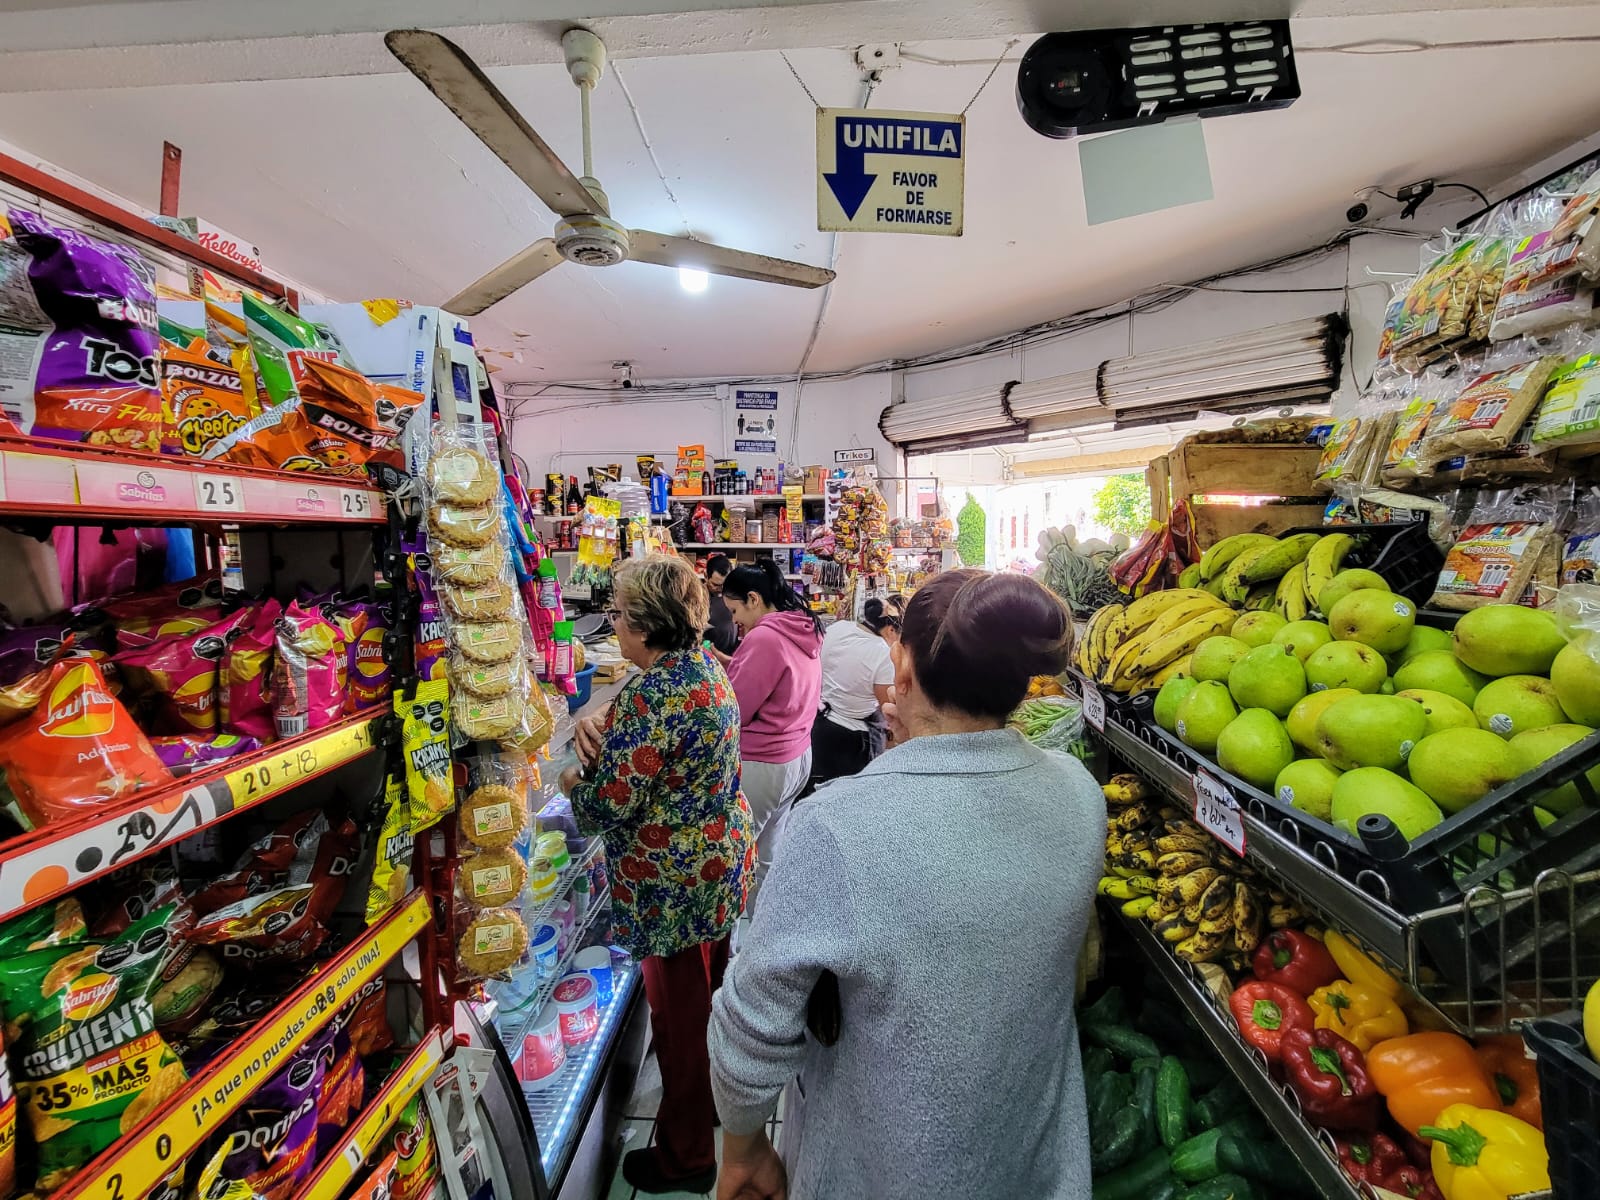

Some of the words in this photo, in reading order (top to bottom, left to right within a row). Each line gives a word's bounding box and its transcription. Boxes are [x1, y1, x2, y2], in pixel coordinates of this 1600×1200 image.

[843, 124, 958, 153] UNIFILA
[893, 171, 938, 188] FAVOR
[906, 191, 924, 206] DE
[876, 207, 953, 226] FORMARSE
[244, 766, 271, 795] 20
[213, 1079, 243, 1105] que
[243, 1058, 262, 1080] no
[261, 1018, 305, 1068] puedes
[336, 965, 357, 990] sólo
[355, 940, 381, 972] UNA!
[36, 1078, 89, 1111] 35%
[93, 1055, 149, 1091] MÁS
[95, 1074, 151, 1101] PRODUCTO
[225, 1097, 315, 1156] Doritos
